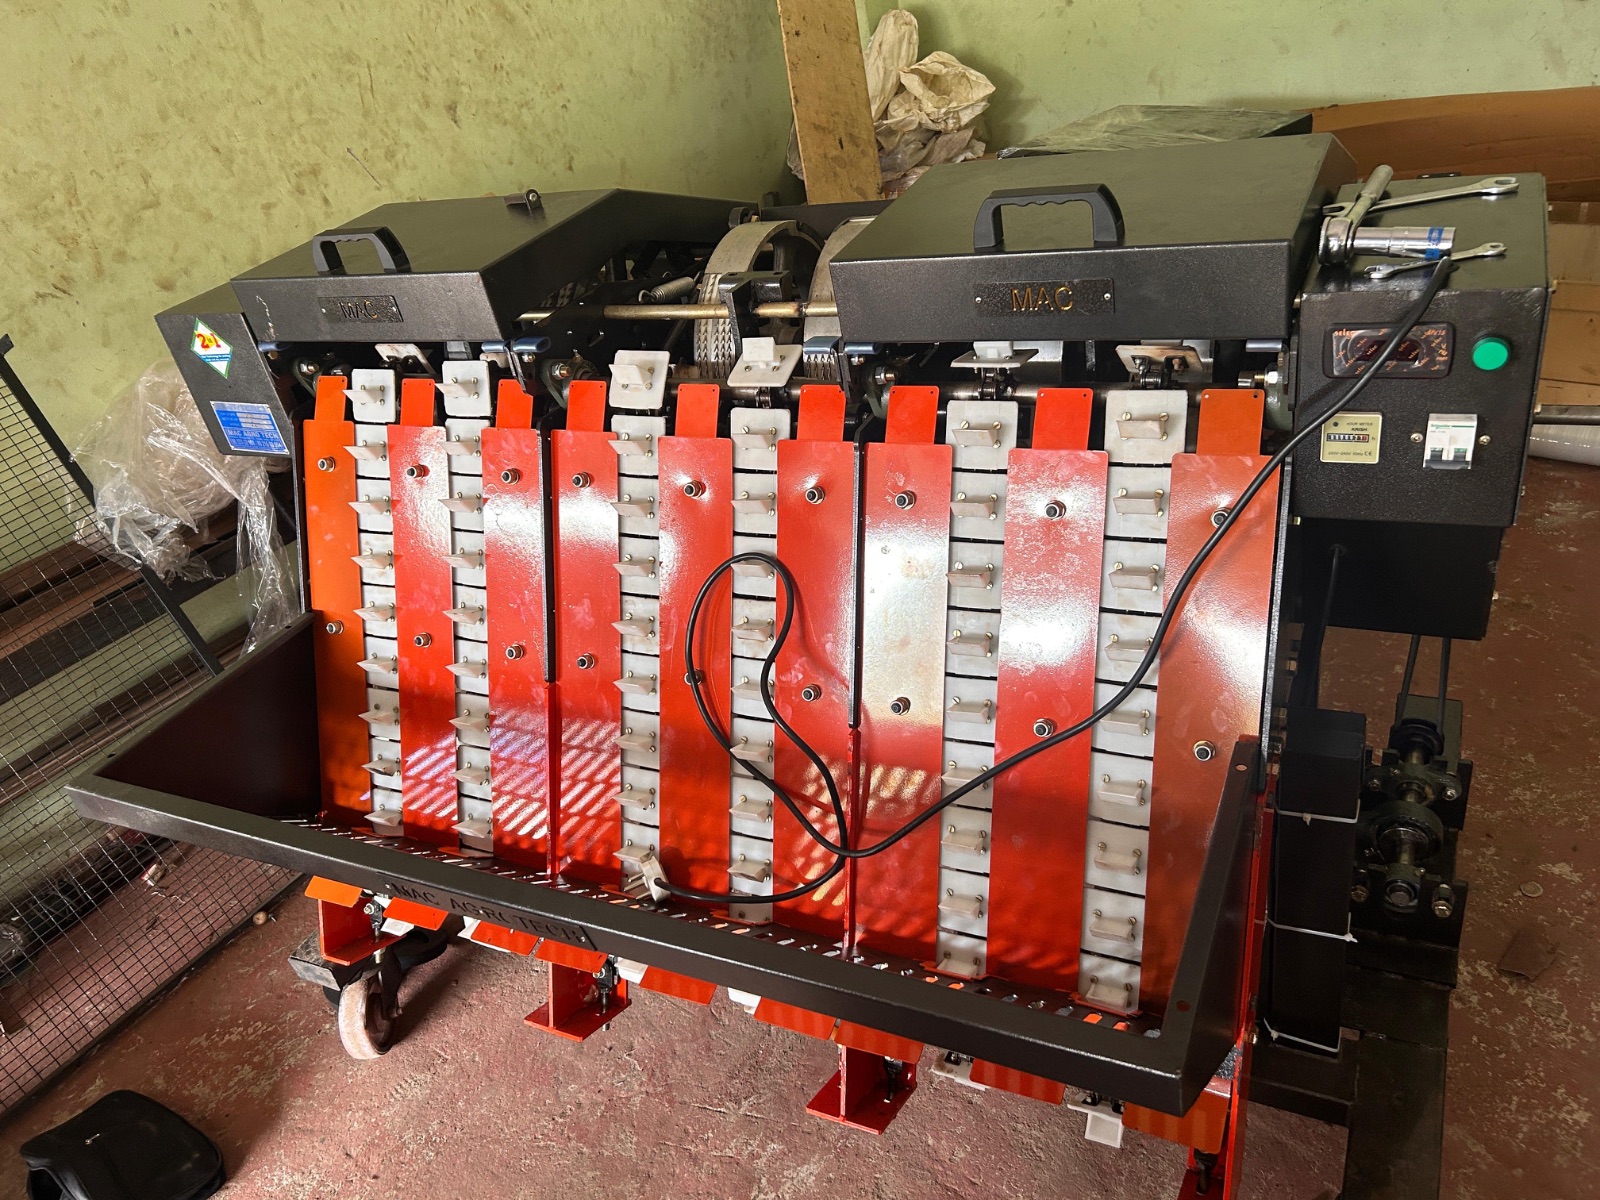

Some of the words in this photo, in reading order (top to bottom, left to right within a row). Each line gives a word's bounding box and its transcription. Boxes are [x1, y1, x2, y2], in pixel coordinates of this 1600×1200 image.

[1010, 285, 1073, 312] MAC
[338, 300, 378, 319] MAC
[196, 333, 210, 348] 2
[391, 882, 441, 906] MAC
